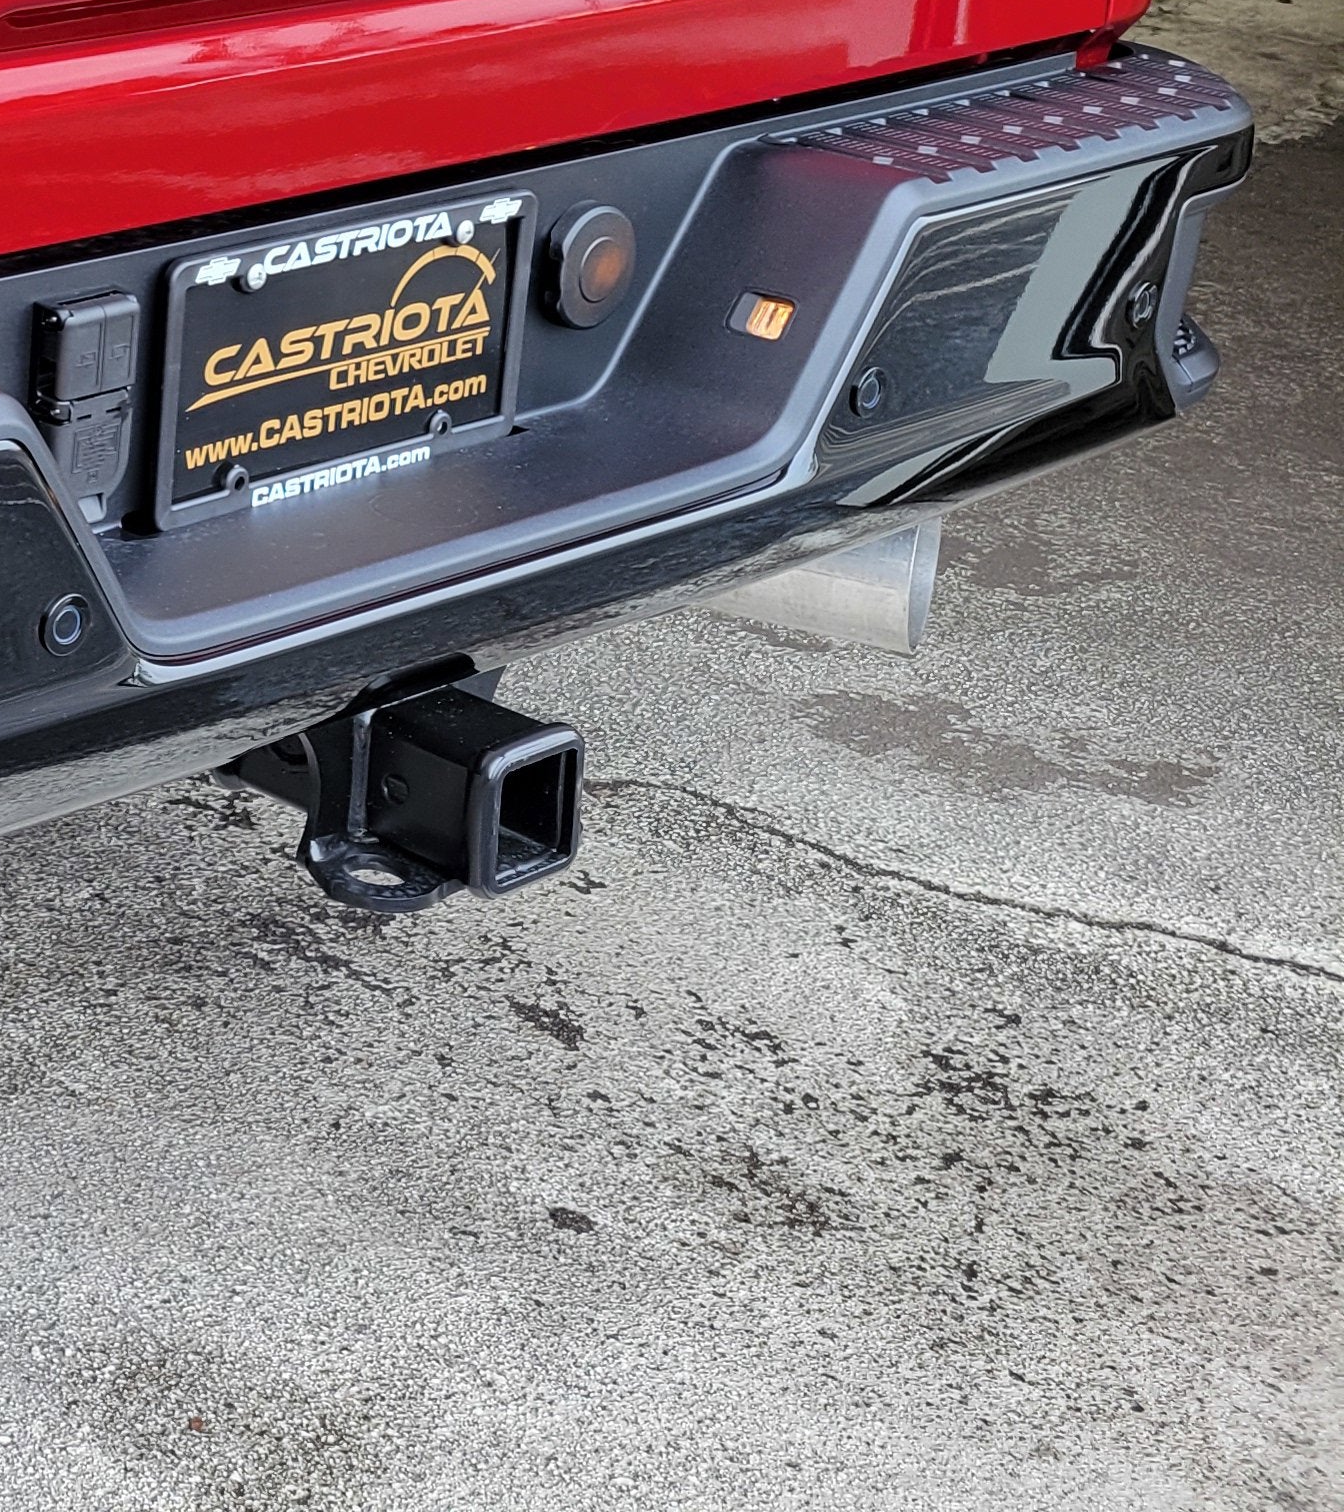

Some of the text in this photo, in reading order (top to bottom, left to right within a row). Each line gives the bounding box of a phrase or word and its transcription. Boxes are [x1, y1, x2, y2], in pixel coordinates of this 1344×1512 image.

[263, 213, 452, 276] CASTRIOTA
[204, 289, 490, 386] CASTRIOTA
[329, 334, 488, 390] CHEVROLET
[185, 374, 487, 470] www.CASTRIOTA.com
[251, 446, 430, 507] CASTRIOTA.com
